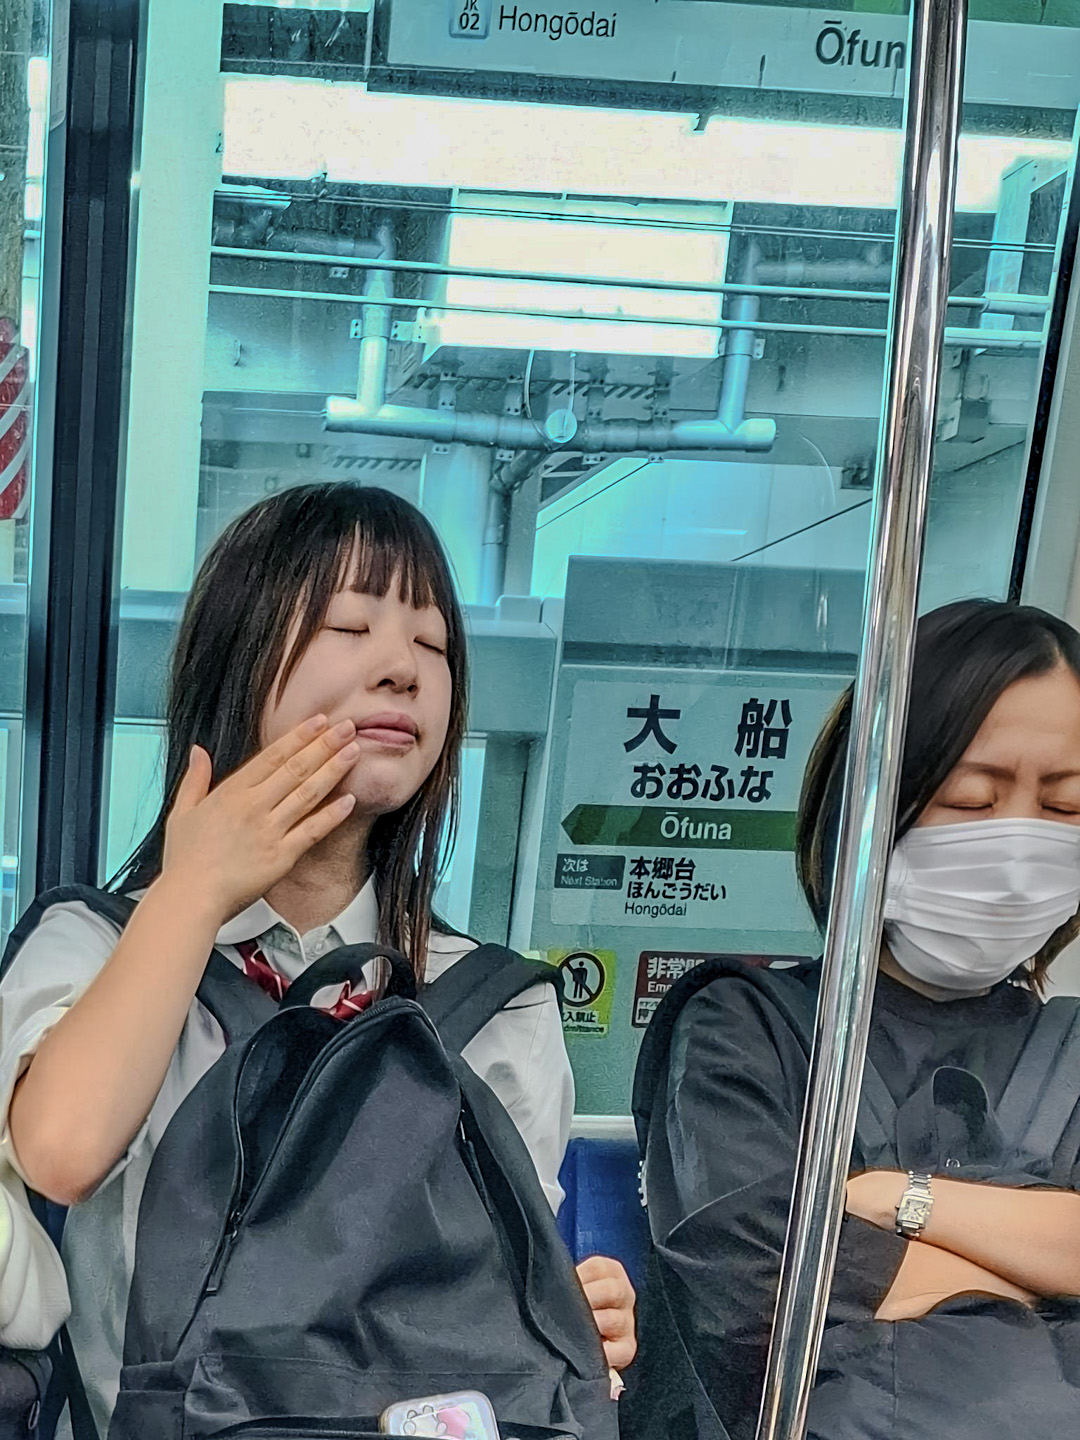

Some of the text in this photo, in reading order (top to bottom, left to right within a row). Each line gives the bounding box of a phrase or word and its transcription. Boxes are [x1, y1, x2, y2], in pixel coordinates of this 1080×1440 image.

[459, 12, 480, 31] 02
[498, 5, 618, 41] Hongōdai
[815, 20, 906, 69] Ōfun
[629, 762, 774, 803] おおふな
[660, 811, 733, 841] Ōfuna
[562, 857, 589, 873] 次は
[629, 855, 697, 881] 本郷台
[627, 881, 727, 901] ほんごうだい
